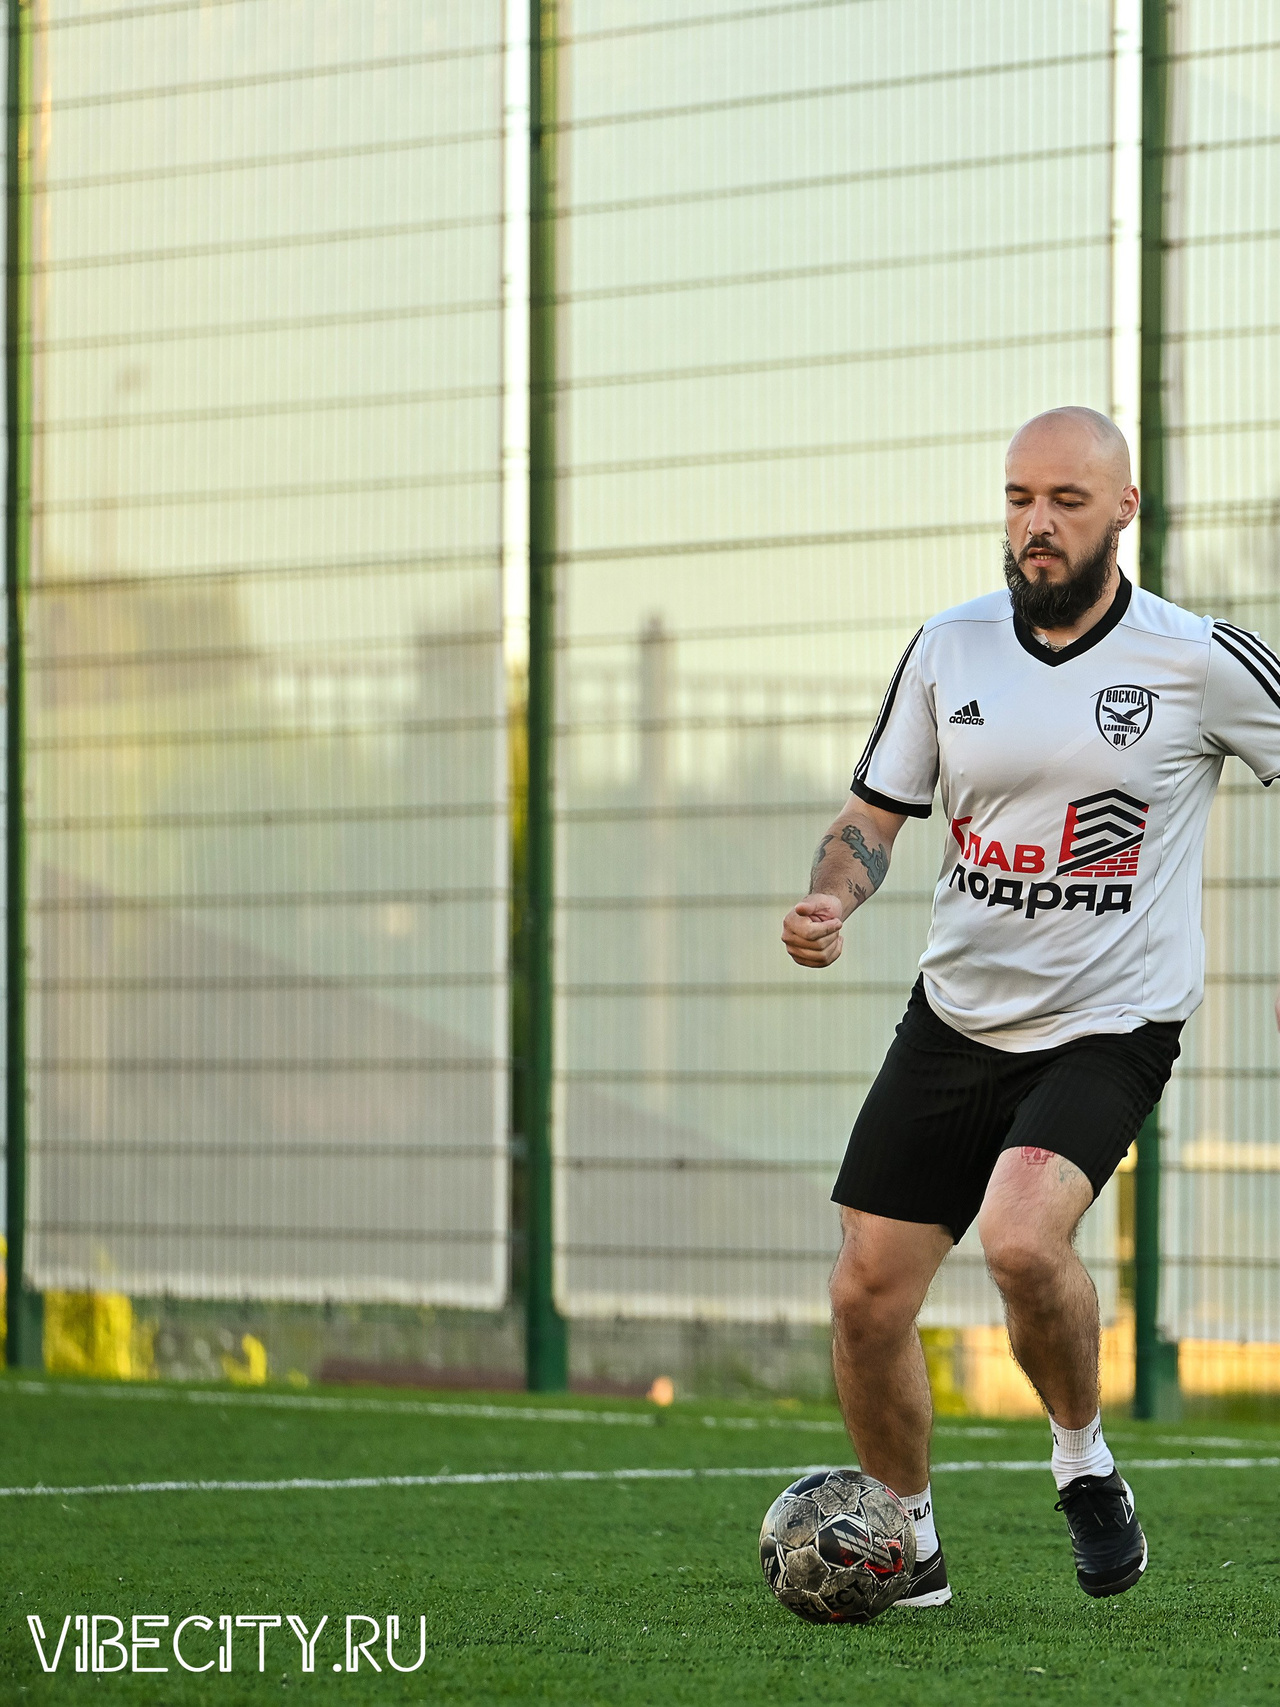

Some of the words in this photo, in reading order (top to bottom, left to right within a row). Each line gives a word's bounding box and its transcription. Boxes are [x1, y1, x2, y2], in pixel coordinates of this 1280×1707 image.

[1105, 690, 1145, 706] ВОСХОД
[949, 714, 985, 726] adidas
[1113, 733, 1127, 746] ФК
